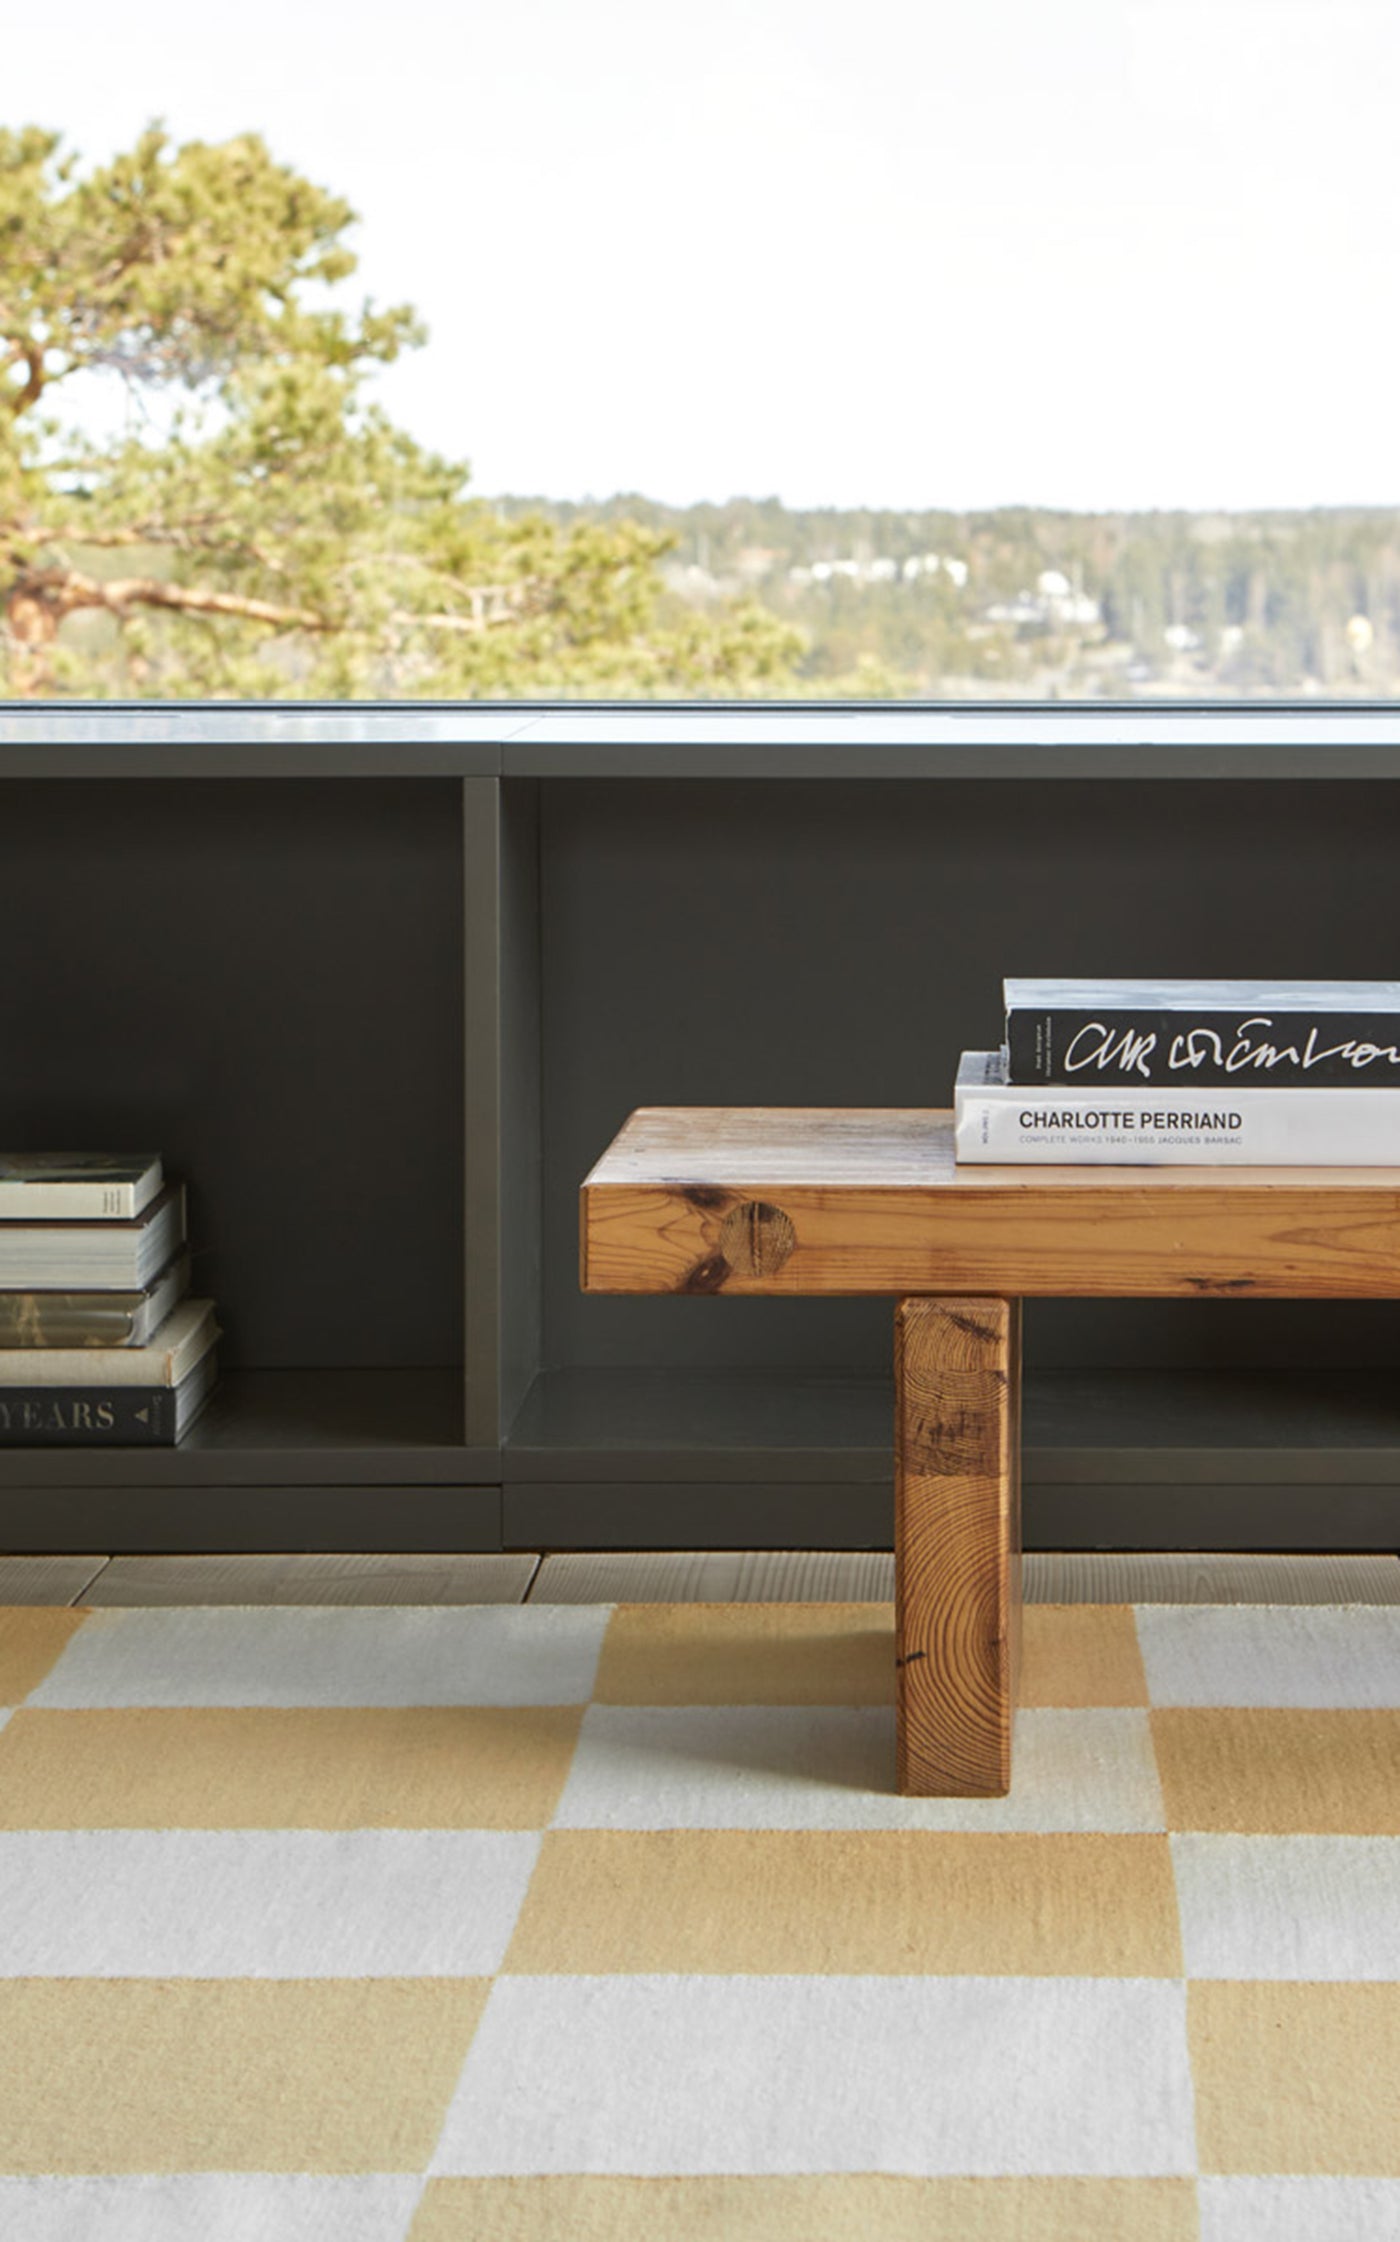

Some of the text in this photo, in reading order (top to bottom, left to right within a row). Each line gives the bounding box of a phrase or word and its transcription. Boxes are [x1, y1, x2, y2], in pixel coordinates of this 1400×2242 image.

[1019, 1111, 1242, 1129] CHARLOTTE PERRIAND
[1019, 1135, 1066, 1144] COMPLETE
[1070, 1135, 1102, 1144] WORKS
[1157, 1136, 1201, 1145] JACQUES
[0, 1402, 114, 1429] YEARS
